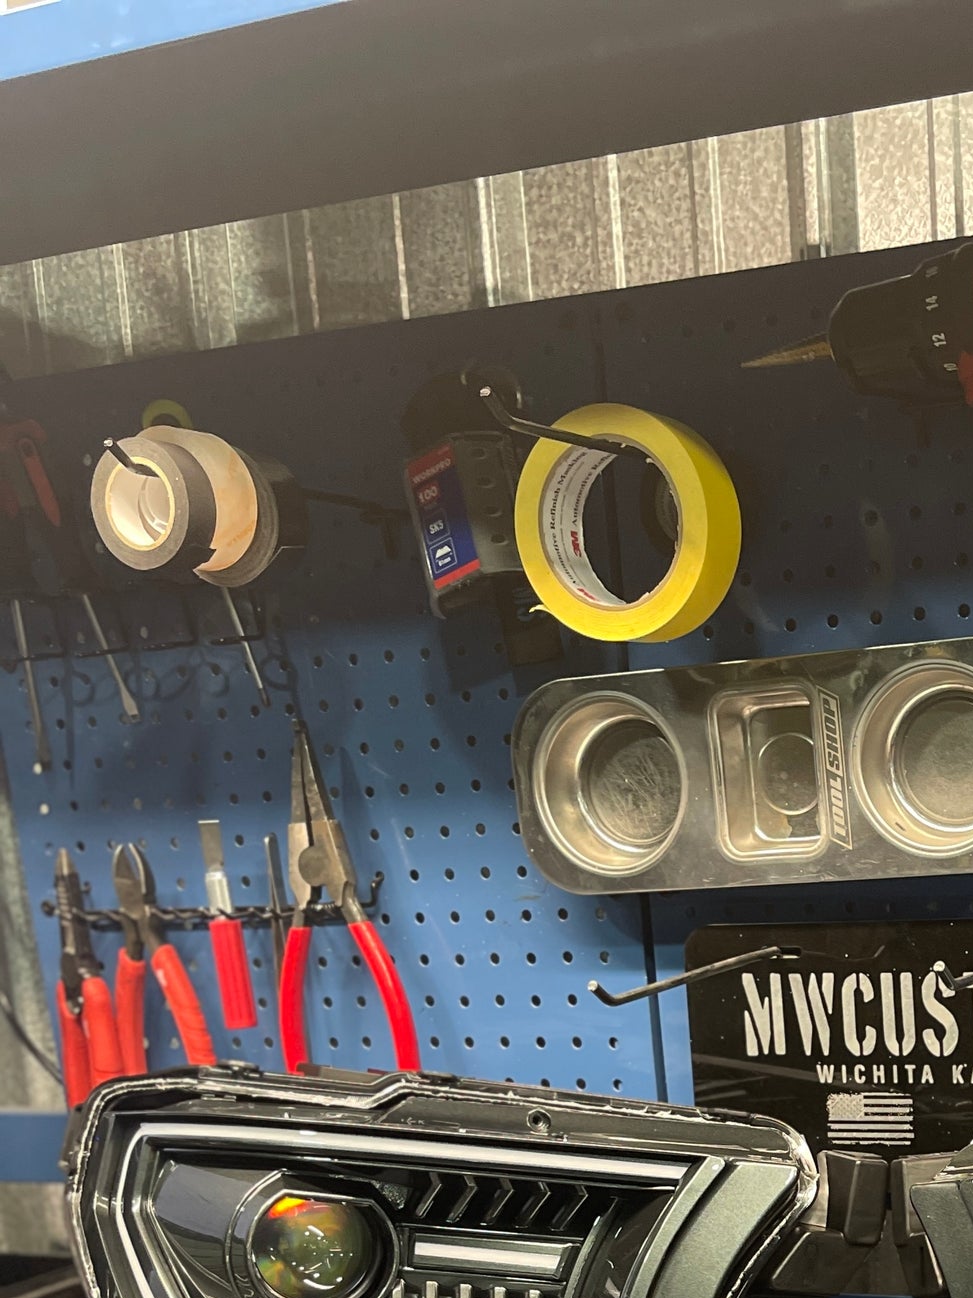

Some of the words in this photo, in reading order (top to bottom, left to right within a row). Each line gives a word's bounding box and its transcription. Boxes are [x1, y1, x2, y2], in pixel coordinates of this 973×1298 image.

[925, 295, 939, 311] 14
[931, 333, 947, 348] 12
[417, 485, 439, 504] 100
[550, 486, 561, 530] Refinish
[571, 472, 593, 526] Automotive
[570, 530, 582, 558] 3M
[823, 697, 840, 771] SHOP
[830, 775, 847, 837] TOOL
[816, 1064, 935, 1085] WICHITA
